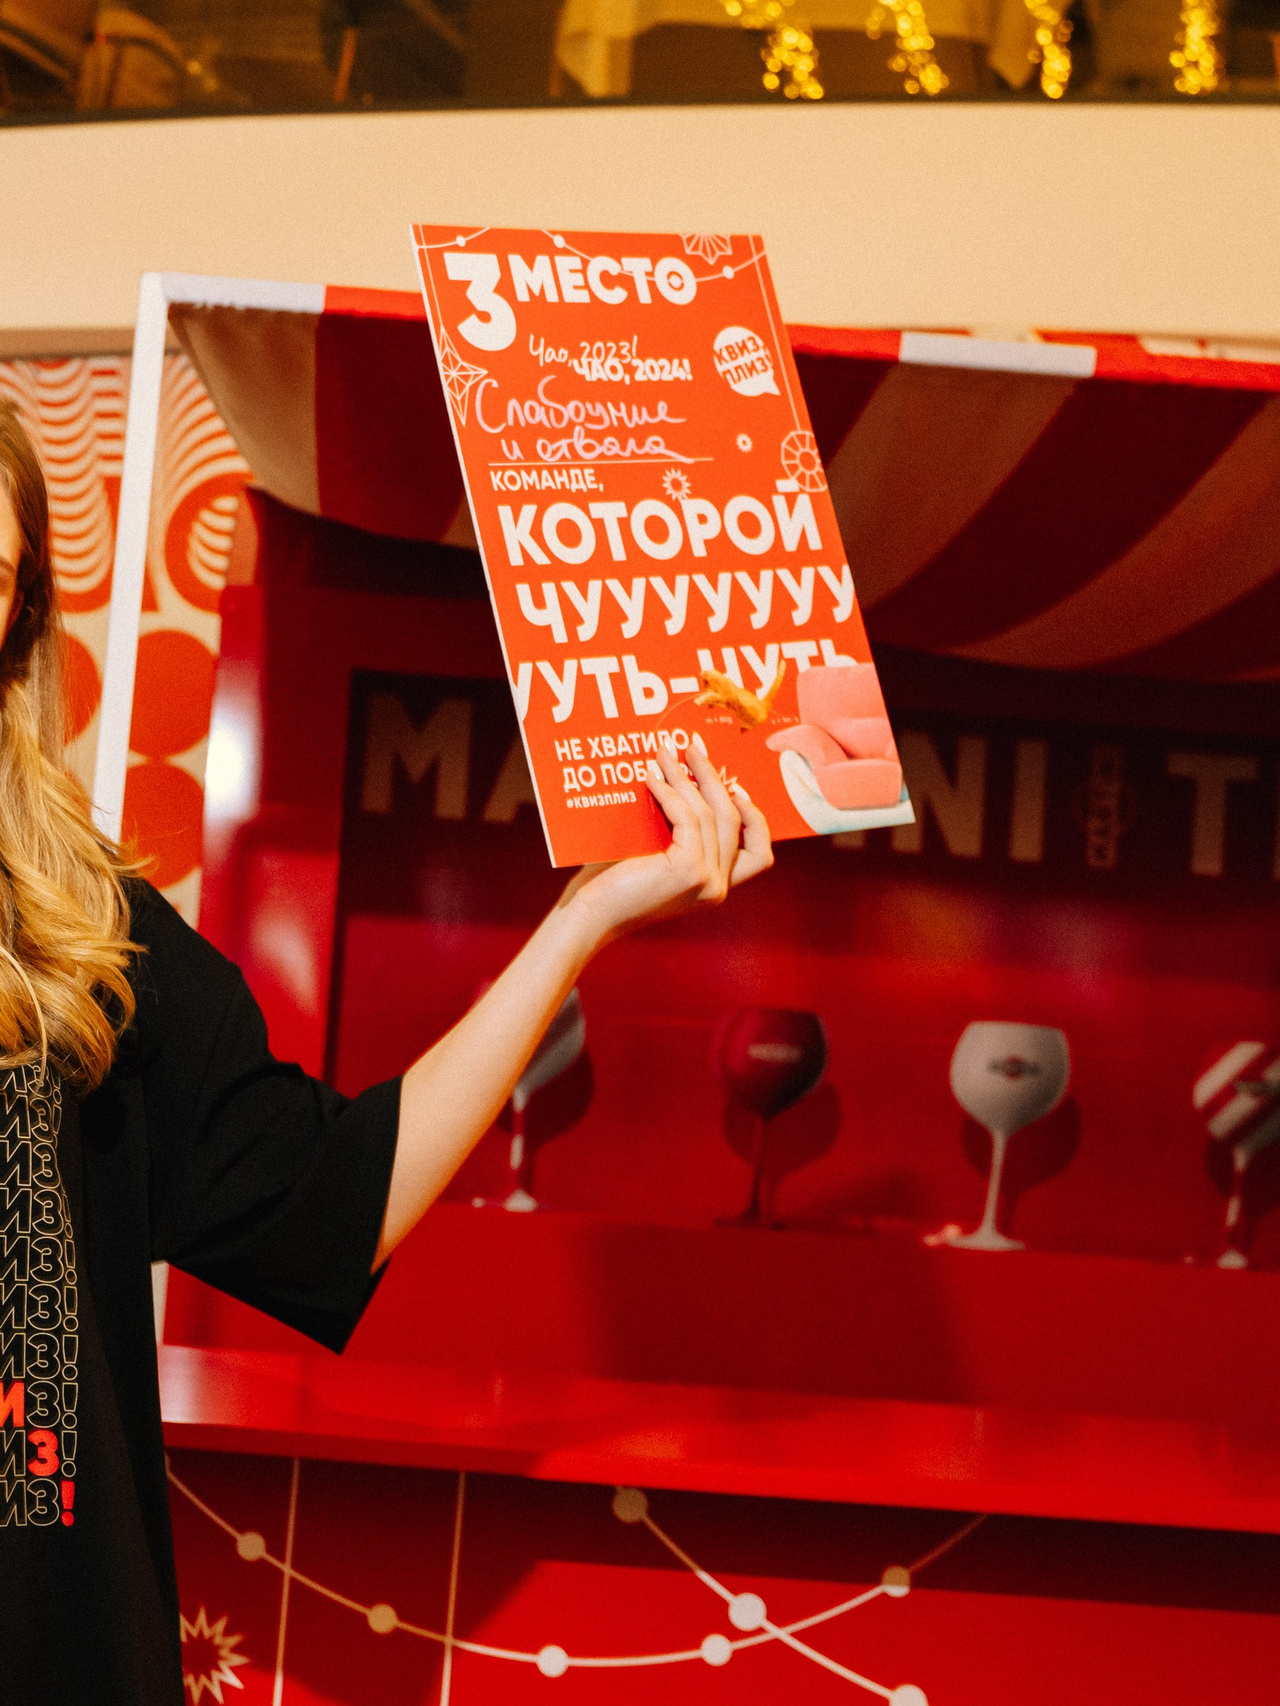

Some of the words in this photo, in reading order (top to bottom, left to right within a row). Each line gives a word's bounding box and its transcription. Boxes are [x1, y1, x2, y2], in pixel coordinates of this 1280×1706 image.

[443, 252, 516, 351] 3
[507, 253, 697, 305] МЕСТО
[580, 334, 638, 364] 2023!
[573, 358, 630, 385] ЧАО,
[631, 358, 693, 381] 2024!
[501, 438, 524, 461] и
[490, 468, 604, 492] КОМАНДЕ,
[497, 479, 822, 566] КОТОРОЙ
[554, 738, 584, 762] НЕ
[562, 766, 596, 793] ДО
[566, 791, 637, 809] #КВИЗПЛИЗ
